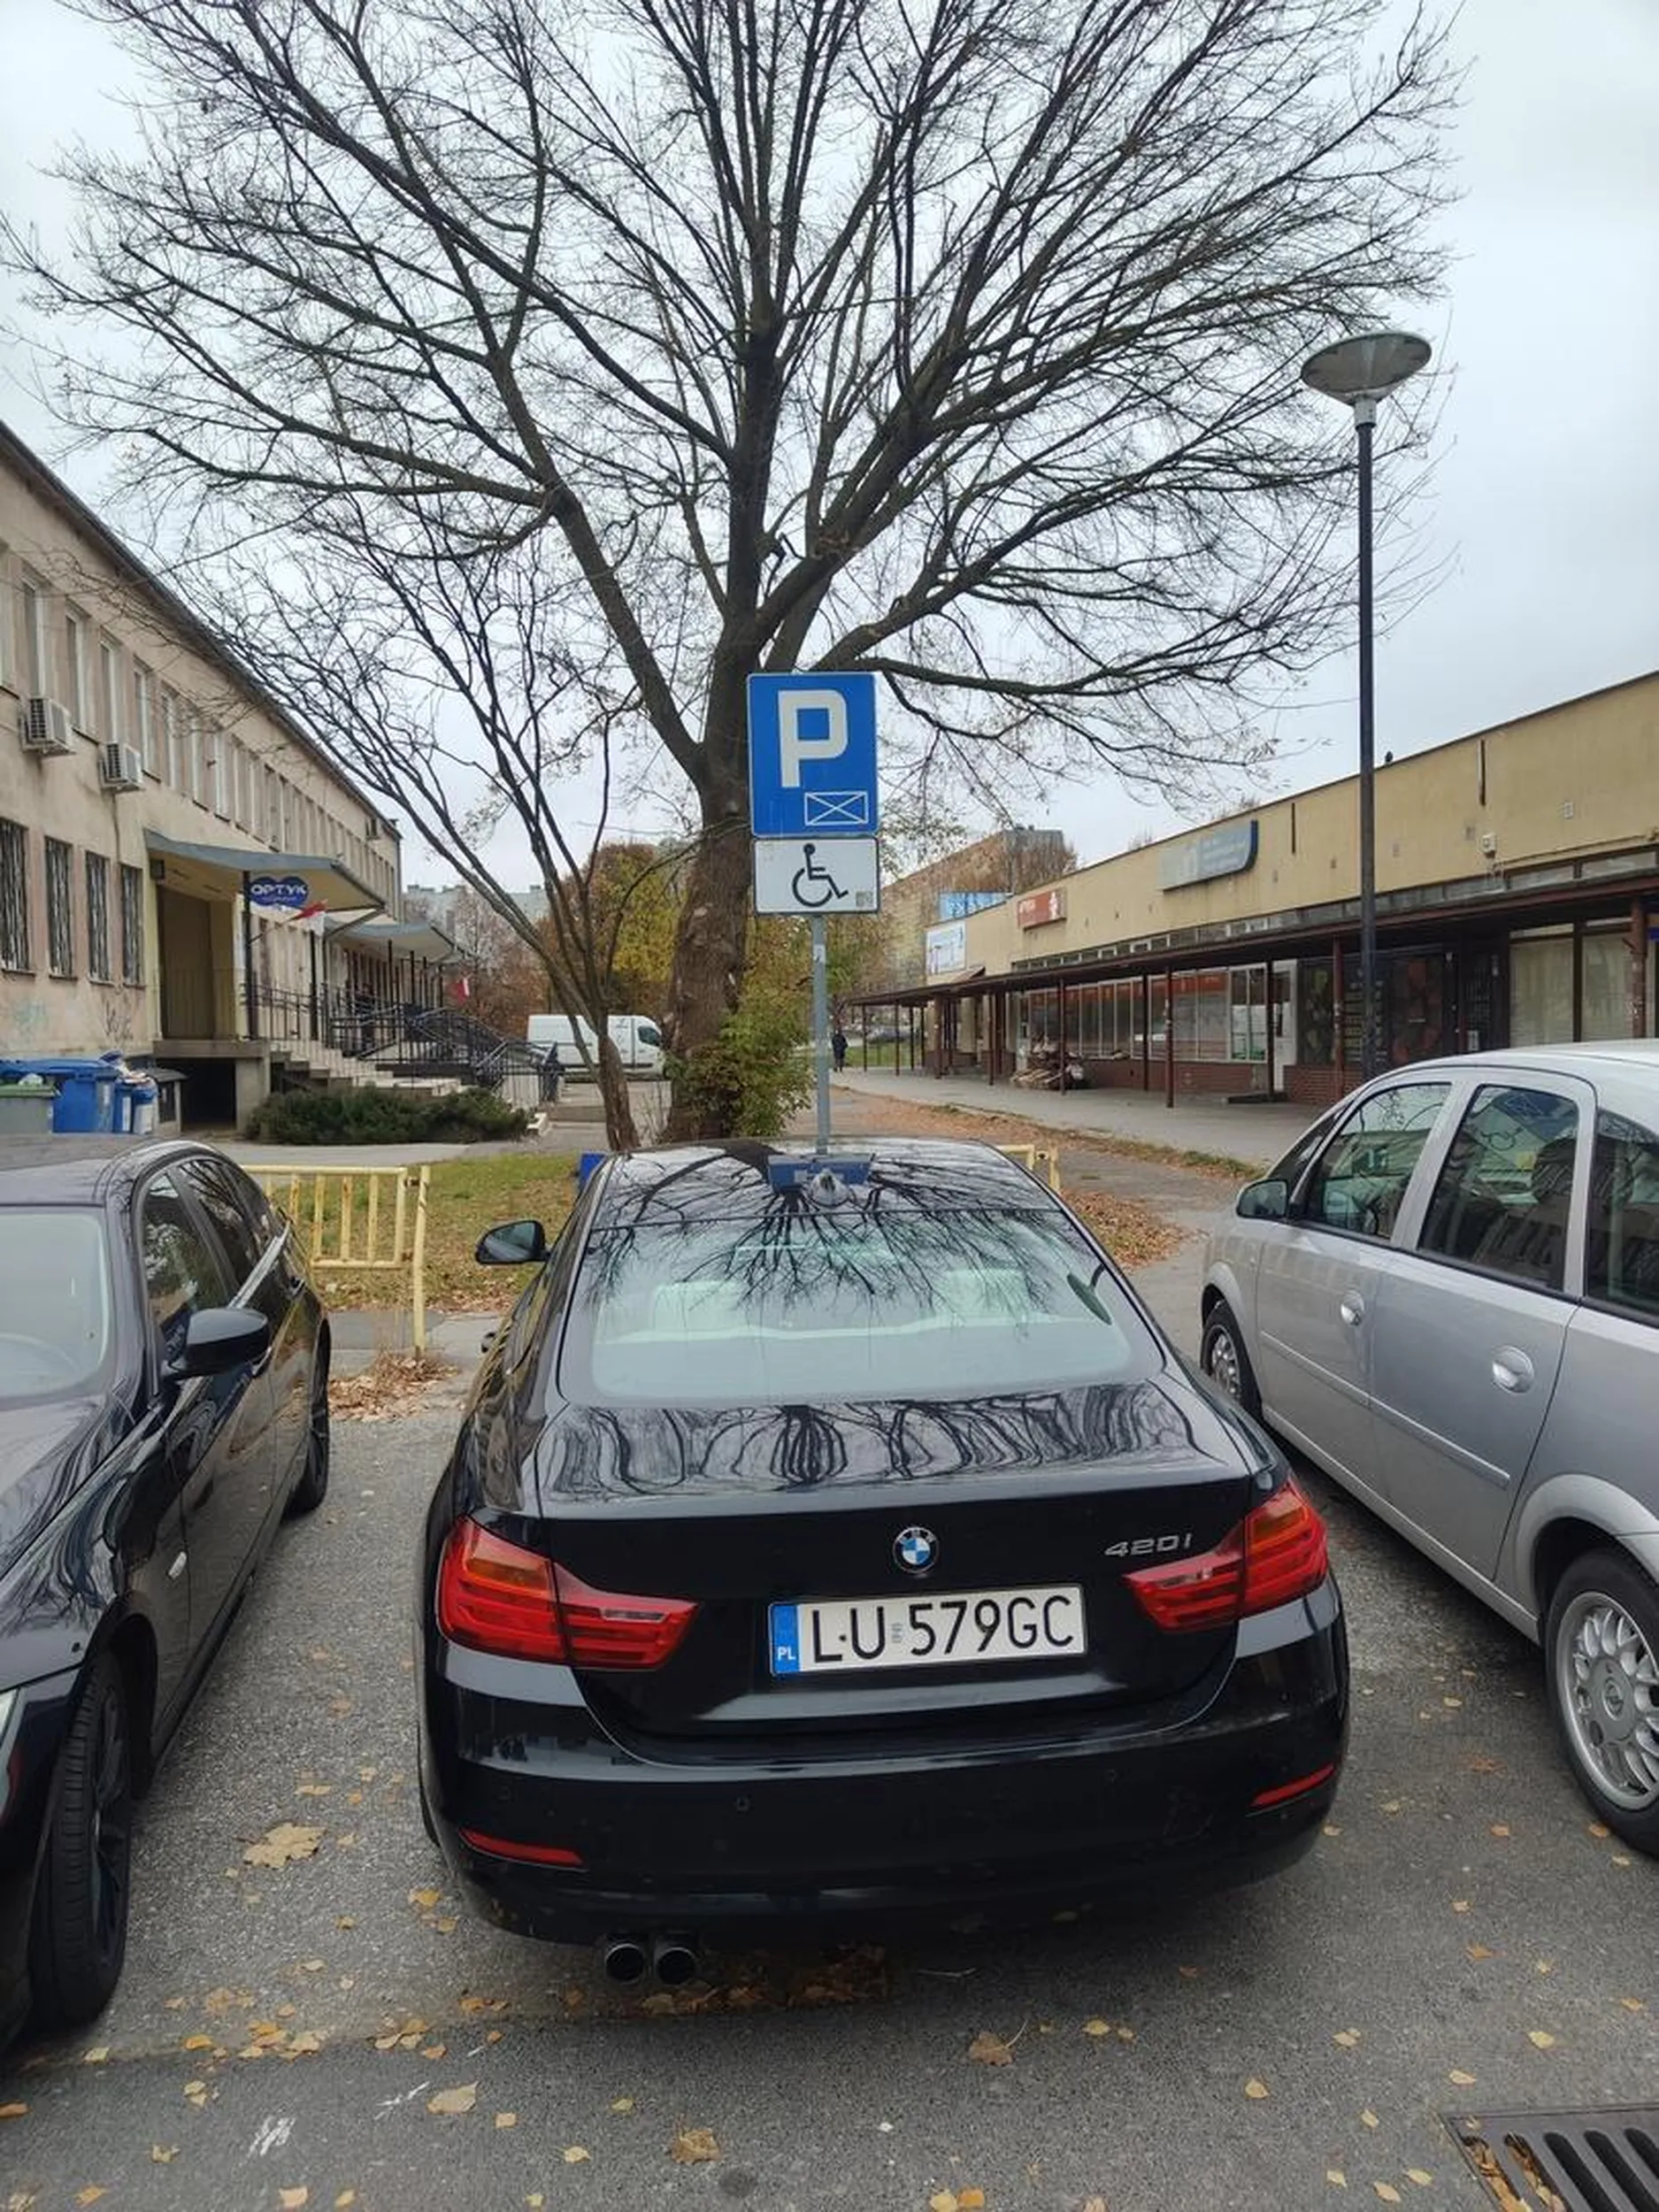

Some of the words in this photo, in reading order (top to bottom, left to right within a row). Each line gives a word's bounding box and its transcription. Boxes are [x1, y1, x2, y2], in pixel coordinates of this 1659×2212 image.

[778, 689, 849, 788] P
[251, 884, 306, 895] OPTYK
[910, 1595, 1074, 1656] 579GC
[778, 1646, 796, 1661] PL
